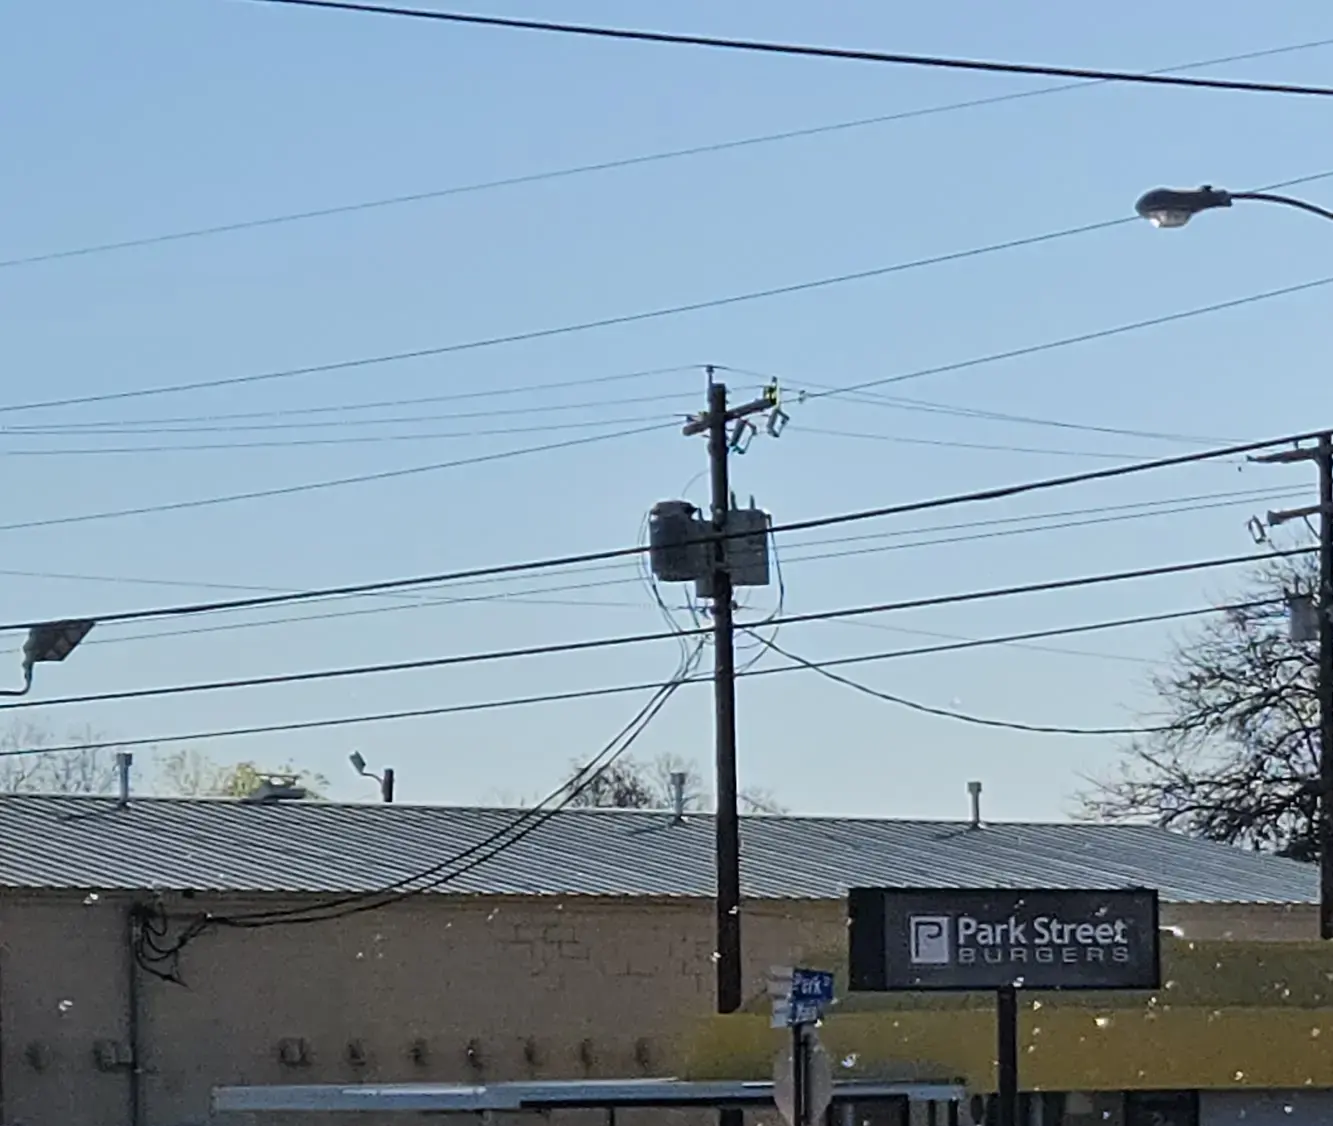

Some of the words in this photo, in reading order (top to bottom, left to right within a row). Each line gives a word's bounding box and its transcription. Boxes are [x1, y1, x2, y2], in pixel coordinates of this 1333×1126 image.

[958, 916, 1028, 945] Park
[1034, 916, 1128, 945] Street
[958, 947, 1129, 964] BURGERS
